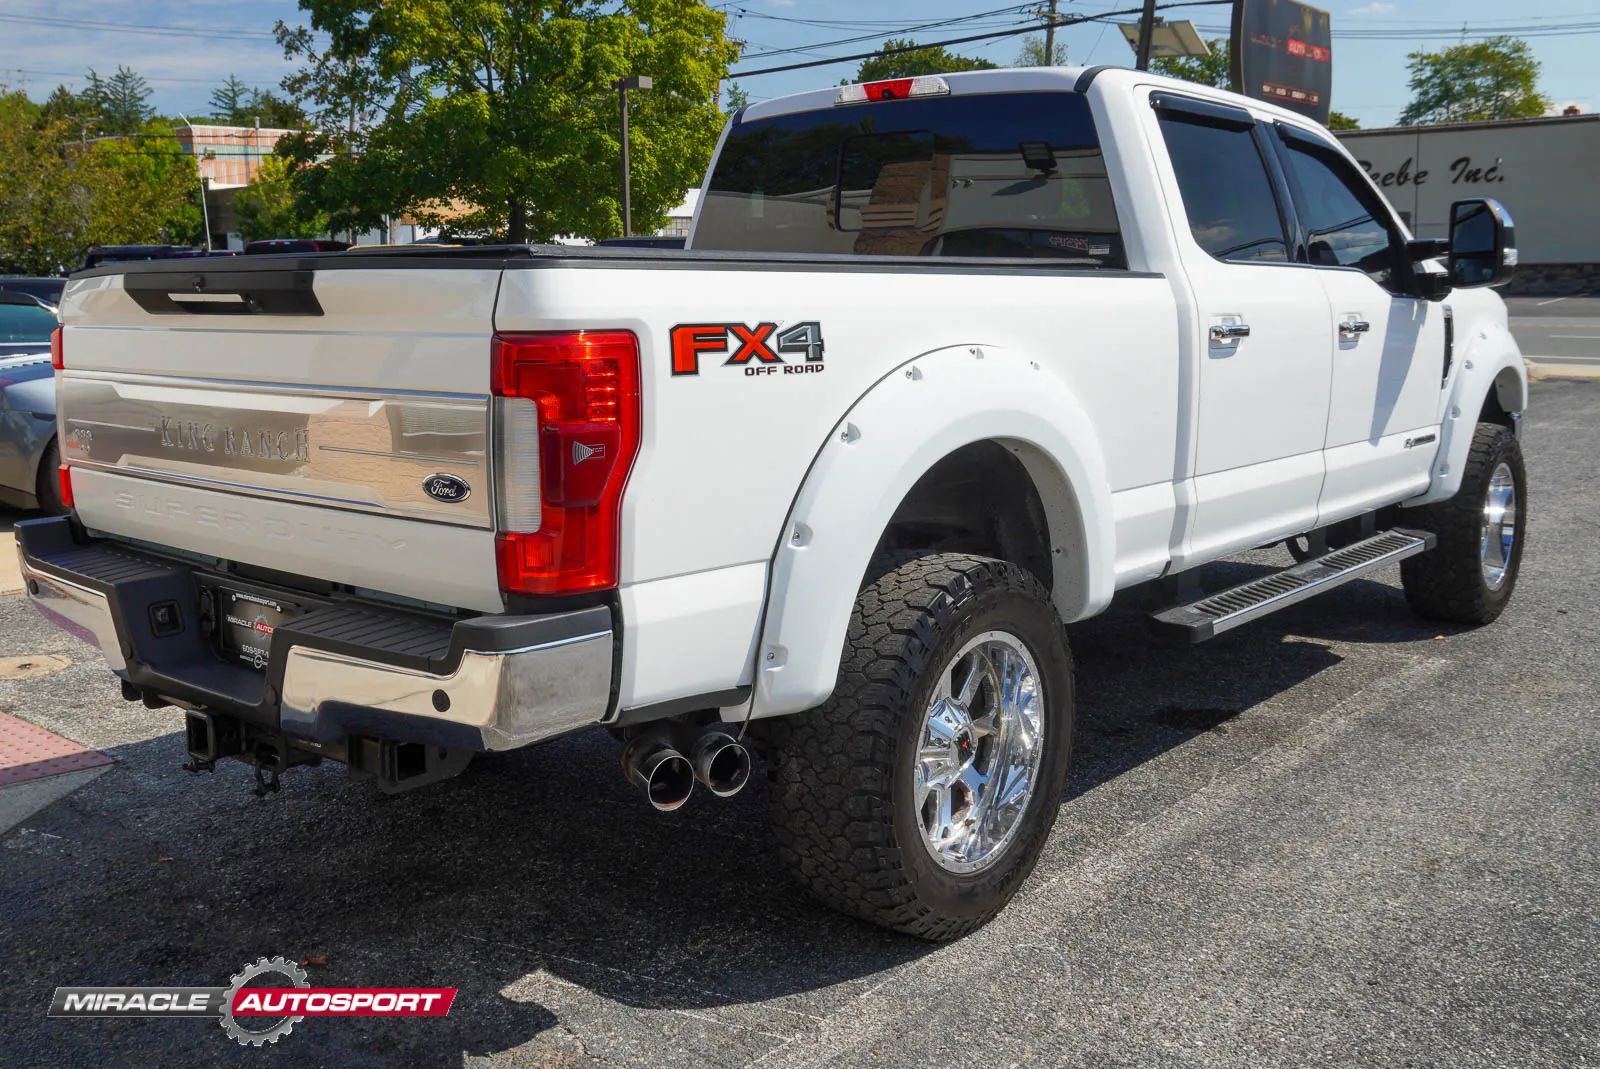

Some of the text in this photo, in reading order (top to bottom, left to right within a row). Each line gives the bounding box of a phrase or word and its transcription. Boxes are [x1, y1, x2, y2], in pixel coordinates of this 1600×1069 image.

[669, 320, 825, 377] FX4
[744, 364, 825, 377] OFF ROAD
[160, 415, 312, 463] KING RANCH
[430, 479, 457, 497] Ford
